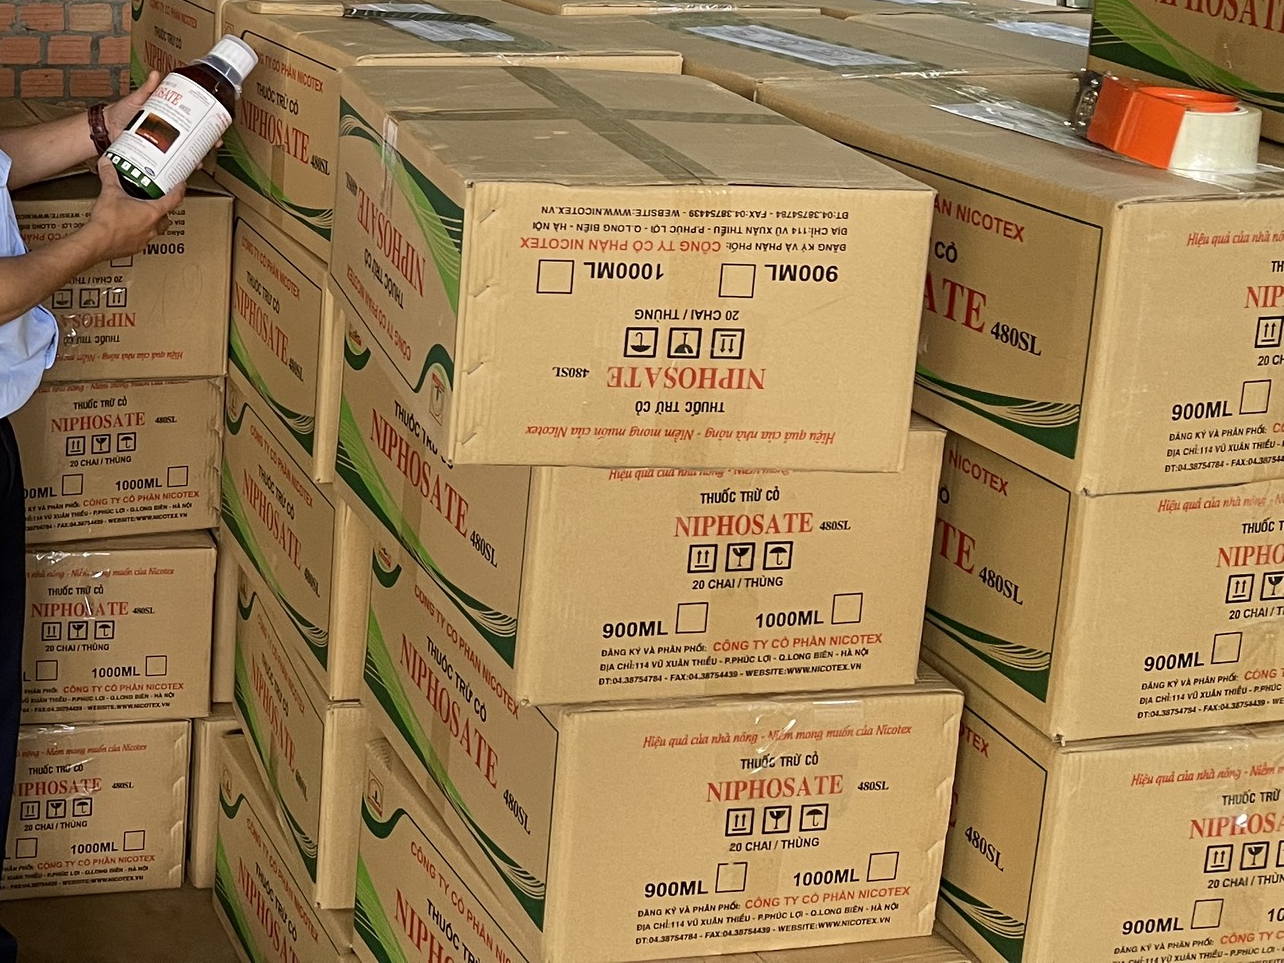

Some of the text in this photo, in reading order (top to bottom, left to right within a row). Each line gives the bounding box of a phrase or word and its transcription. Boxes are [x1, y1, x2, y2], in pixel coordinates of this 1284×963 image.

[289, 98, 298, 116] CỎ
[240, 98, 309, 164] NIPHOSATE
[956, 204, 1025, 243] NICOTEX
[357, 187, 426, 298] NIPHOSATE
[519, 236, 584, 250] NICOTEX
[656, 240, 675, 251] TY
[679, 240, 721, 254] CÔNG
[935, 241, 957, 263] CỎ
[583, 261, 838, 282] 900ML 1000ML
[634, 308, 739, 322] 20 CHAI THÙNG
[991, 322, 1041, 356] 480SL
[551, 366, 766, 389] NIPHOSATE 480SL
[634, 400, 724, 416] THUỐC TRỪ CỎ
[1172, 401, 1233, 421] 900ML
[51, 412, 145, 433] NIPHOSATE
[524, 425, 836, 445] Hiệu quả của nhà nông Niềm mong muốn của Nicotex
[949, 450, 1008, 496] NICOTEX
[115, 478, 162, 491] 1000ML
[370, 408, 497, 568] NIPHOSATE 480SL
[699, 485, 779, 504] THUỐC TRỪ CỎ
[673, 512, 851, 537] NIPHOSATE 480SL
[1242, 517, 1275, 534] THUỐC
[691, 575, 783, 590] 20 CHAI THÙNG
[979, 567, 1023, 605] 480SL
[602, 609, 824, 638] 900ML 1000ML
[1229, 608, 1268, 620] 20 CHAI
[712, 639, 749, 651] CÔNG
[752, 639, 768, 650] TY
[829, 632, 882, 645] NICOTEX
[1144, 652, 1204, 672] 900ML
[92, 667, 140, 678] 1000ML
[482, 665, 519, 719] NICOTEX
[474, 696, 487, 722] CỎ
[399, 633, 531, 835] NIPHOSATE 480SL
[779, 752, 802, 767] TRỪ
[804, 750, 818, 765] CỎ
[706, 774, 889, 802] NIPHOSATE 480SL
[1222, 789, 1281, 805] THUỐC TRỪ
[71, 842, 118, 854] 1000ML
[728, 836, 819, 852] 20 CHAI THÙNG
[965, 826, 1004, 872] 480SL
[644, 868, 859, 898] 900ML 1000ML
[1208, 877, 1248, 888] 20 CHAI
[1122, 917, 1183, 935] 900ML
